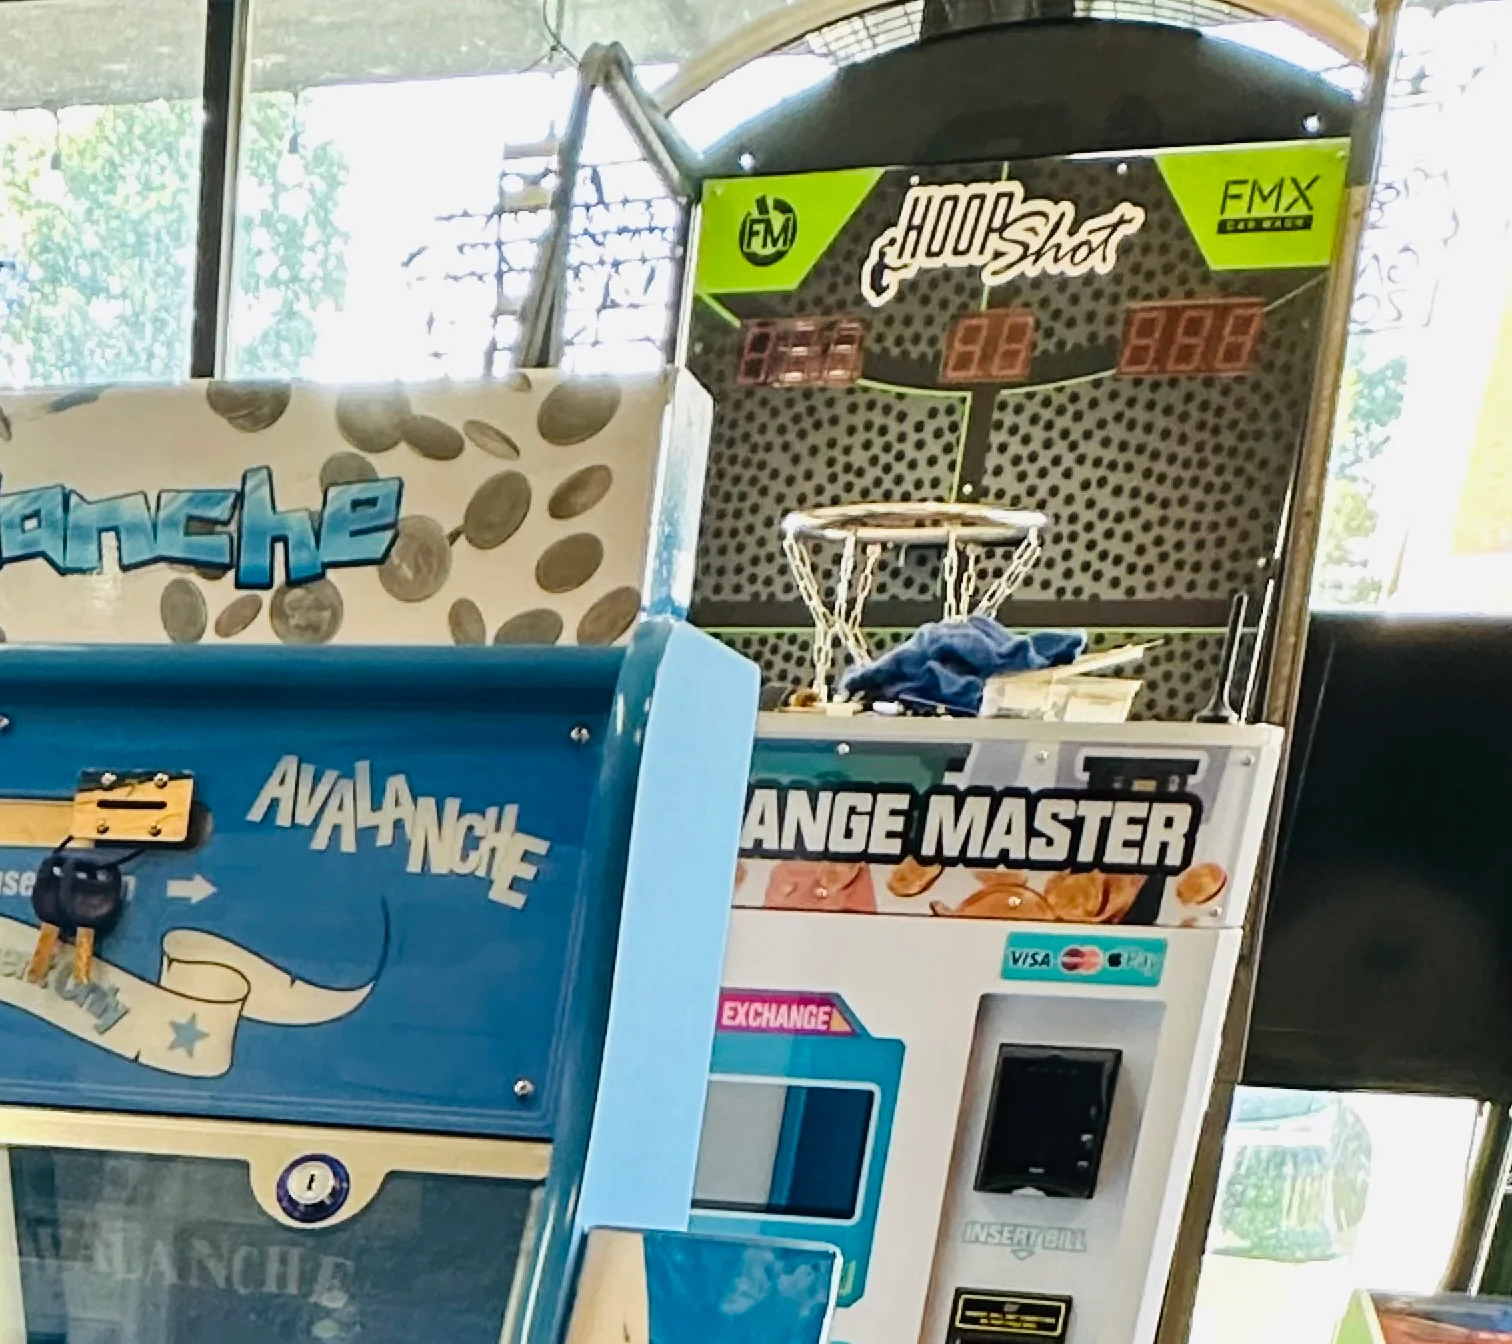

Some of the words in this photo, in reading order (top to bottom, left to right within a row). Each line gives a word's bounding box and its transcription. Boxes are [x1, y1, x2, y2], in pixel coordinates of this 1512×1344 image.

[1219, 174, 1321, 215] FMX
[745, 218, 795, 250] FM
[896, 186, 1017, 264] HOOP
[989, 205, 1140, 276] Shot
[244, 754, 552, 910] AVALANCHE
[739, 787, 913, 857] ANGE
[920, 792, 1194, 869] MASTER
[1010, 950, 1052, 968] VISA
[54, 958, 130, 1035] Only
[720, 999, 833, 1031] EXCHANGE
[963, 1220, 1036, 1249] INSERT
[1042, 1226, 1088, 1253] BILL
